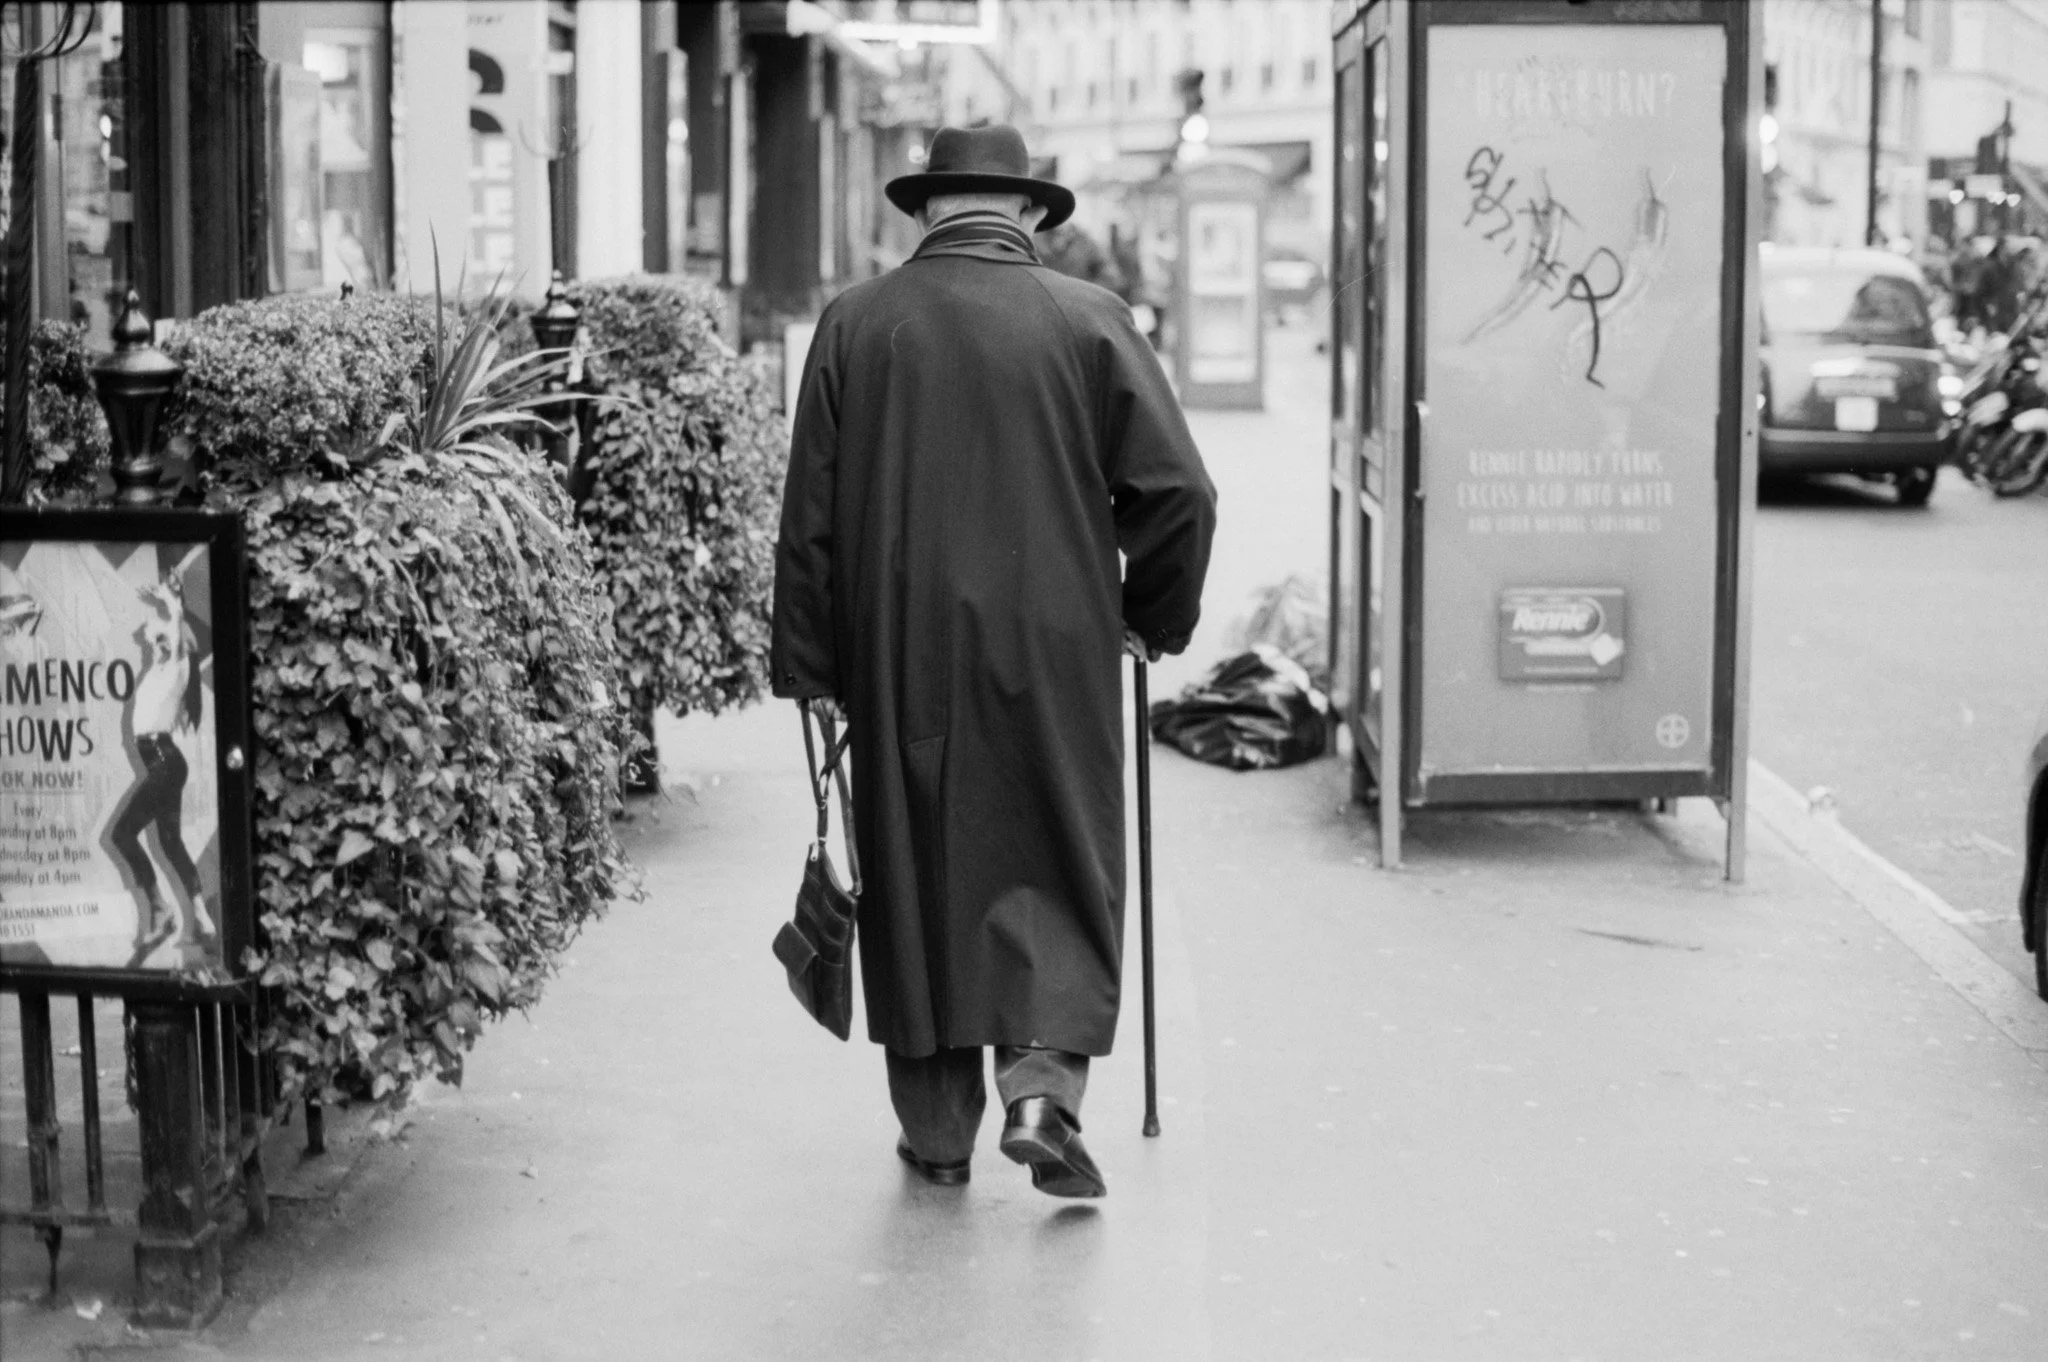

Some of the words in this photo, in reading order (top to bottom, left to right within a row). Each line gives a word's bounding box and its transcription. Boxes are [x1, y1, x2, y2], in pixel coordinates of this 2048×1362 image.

[0, 658, 134, 705] MENCO
[32, 770, 83, 788] NOW!
[0, 822, 32, 842] esday
[48, 847, 59, 862] at
[63, 846, 91, 864] 8pm
[38, 871, 50, 884] at
